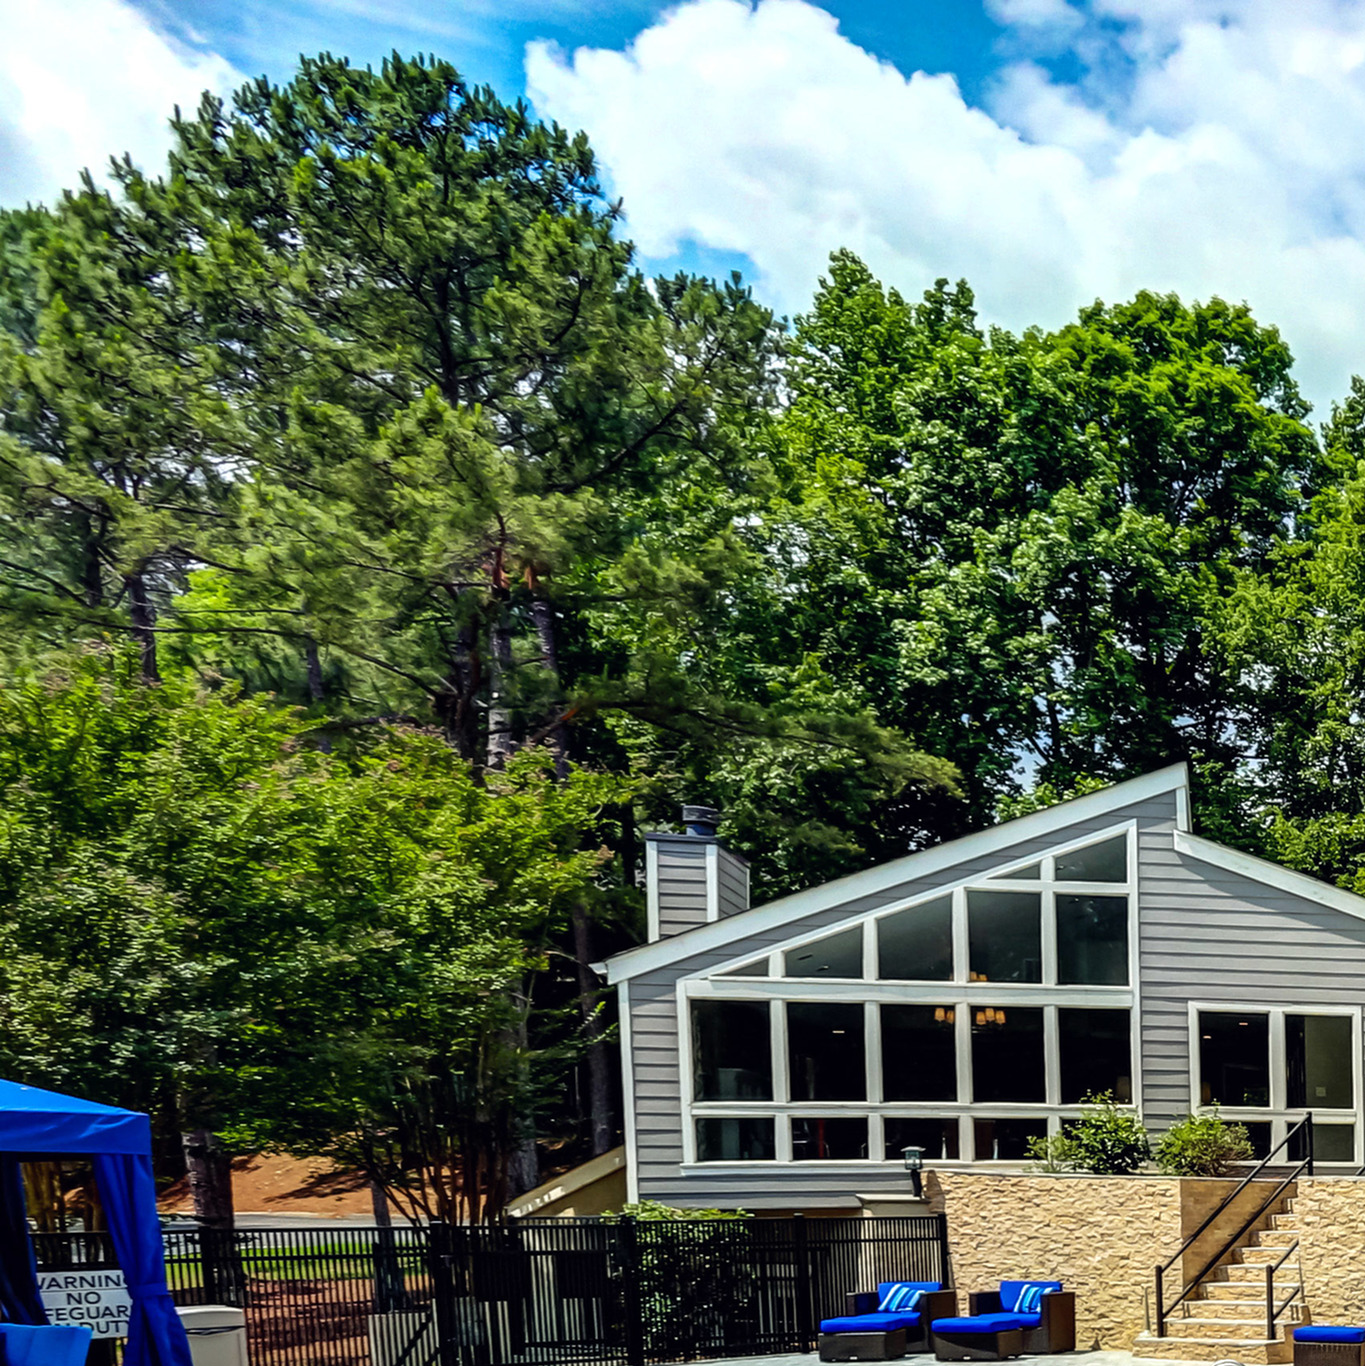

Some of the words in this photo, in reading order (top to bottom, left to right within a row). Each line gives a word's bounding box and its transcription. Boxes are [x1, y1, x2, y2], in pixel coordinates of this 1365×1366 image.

[38, 1274, 126, 1290] ARNIN
[67, 1291, 101, 1305] NO
[44, 1305, 130, 1321] FEGUAR
